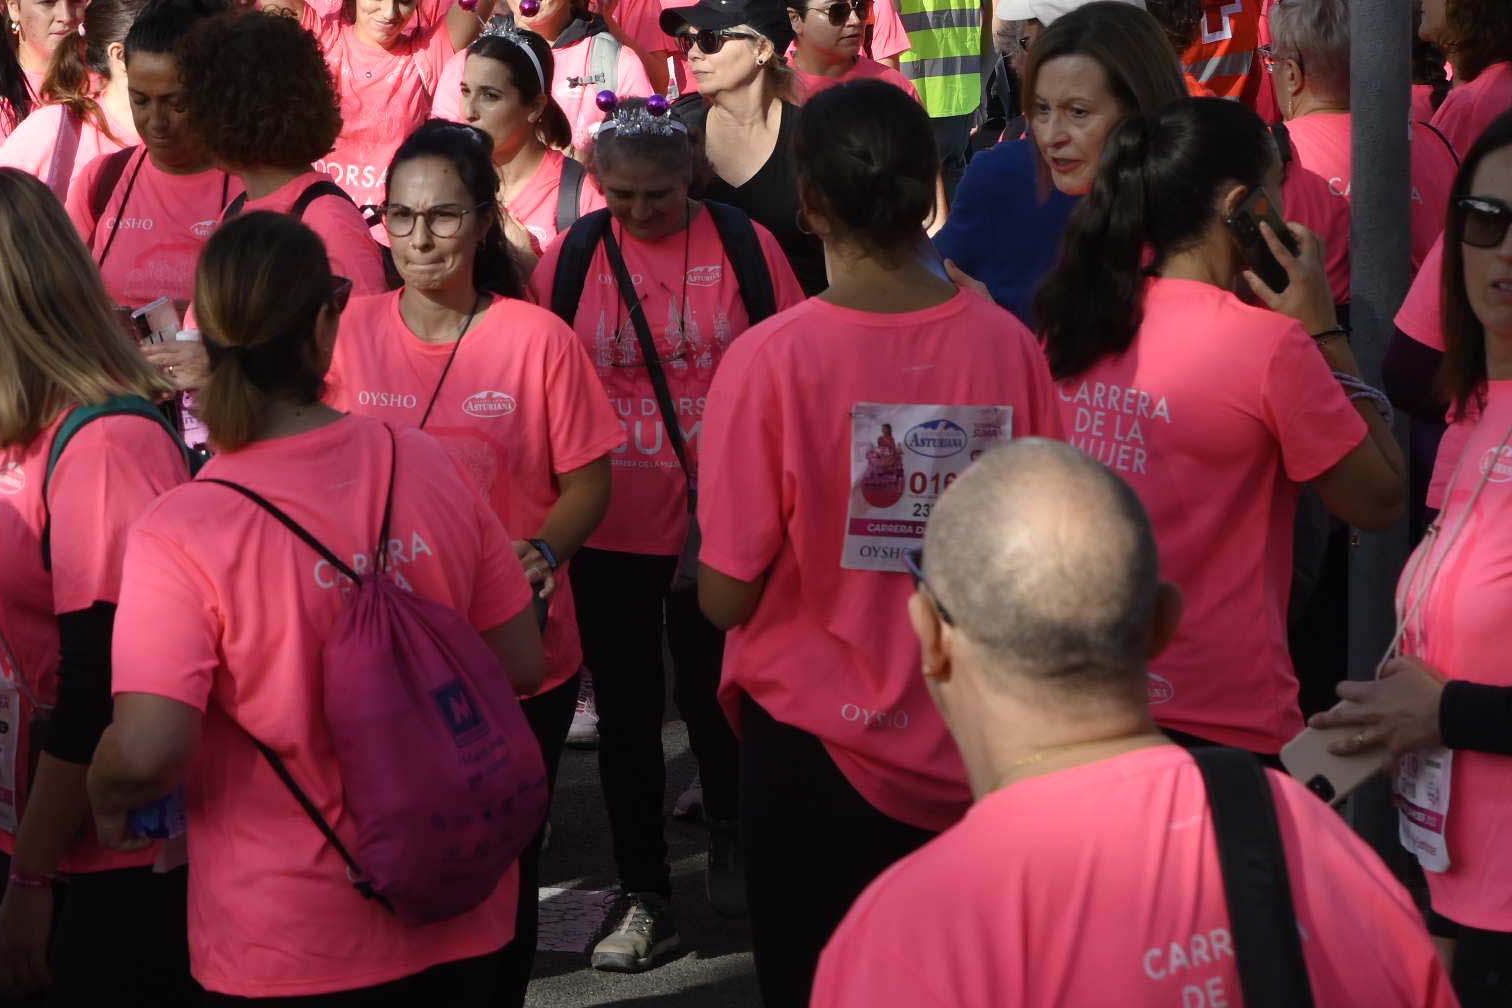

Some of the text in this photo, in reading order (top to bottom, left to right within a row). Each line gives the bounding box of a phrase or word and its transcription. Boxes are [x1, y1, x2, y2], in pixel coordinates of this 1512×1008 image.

[598, 271, 643, 285] OYO
[358, 389, 416, 408] OYSHO
[465, 397, 514, 410] ASTURIANA
[1060, 380, 1171, 423] CARRERA
[1074, 406, 1144, 444] DE LA
[909, 433, 964, 449] ASTURIANA
[913, 502, 934, 518] 23
[867, 522, 913, 534] CARRERA
